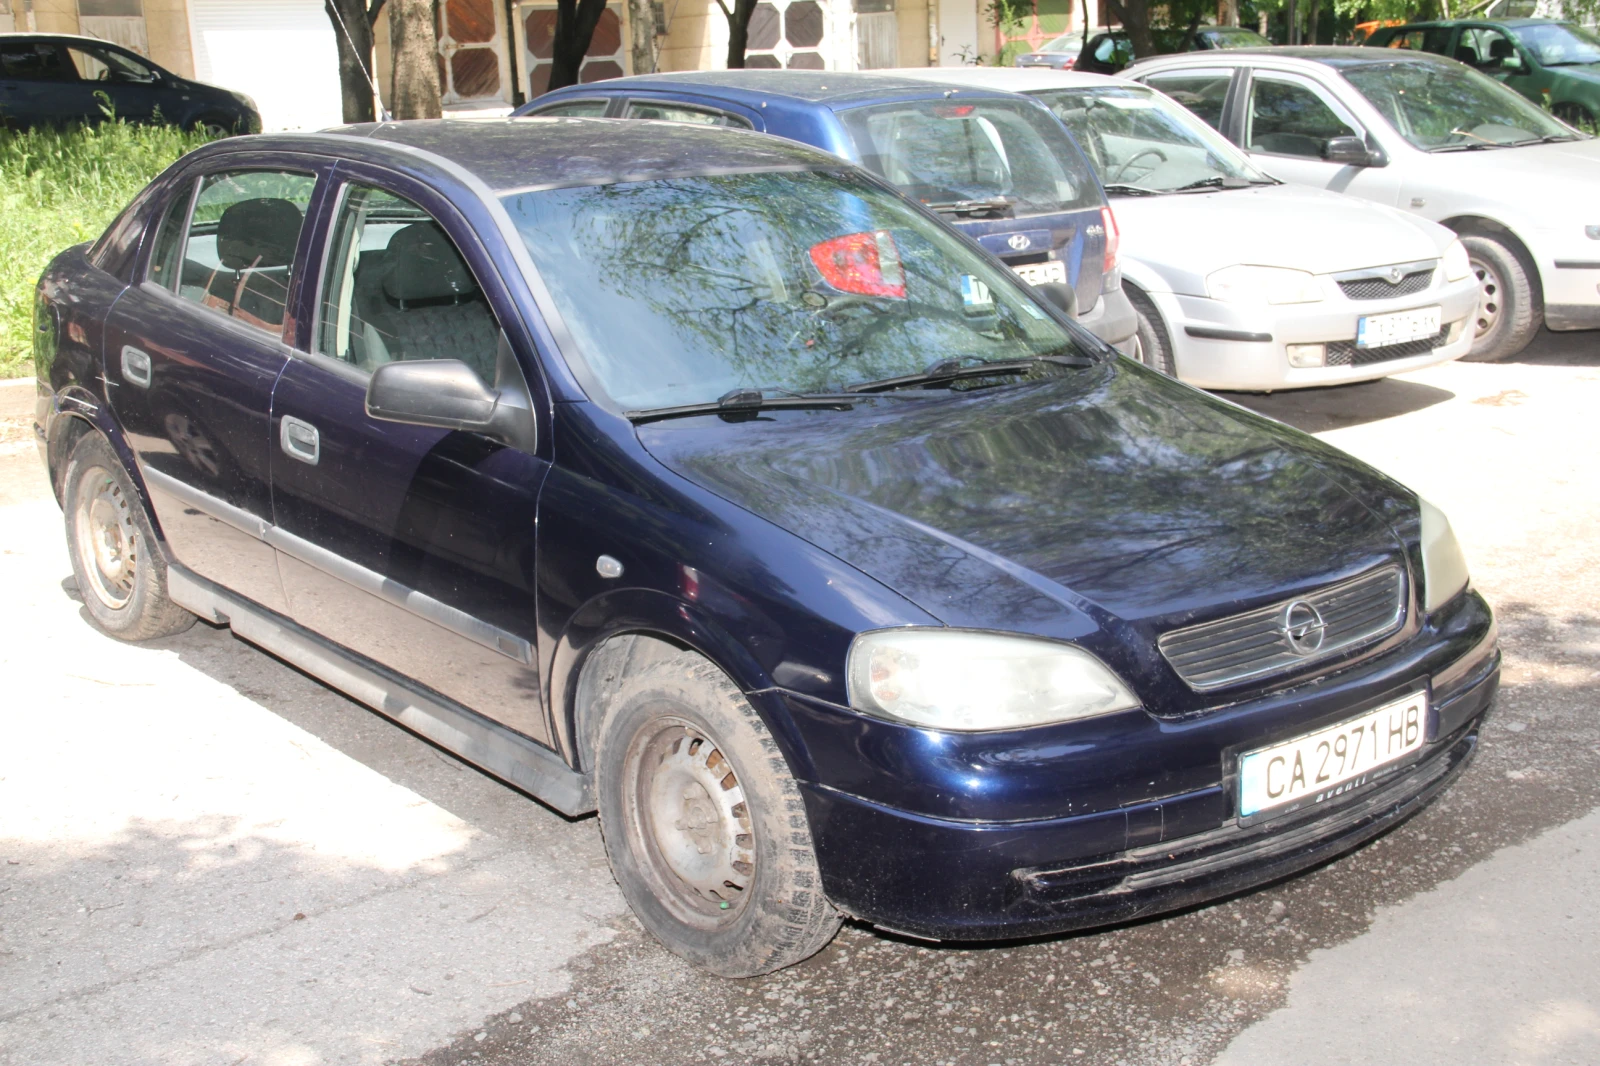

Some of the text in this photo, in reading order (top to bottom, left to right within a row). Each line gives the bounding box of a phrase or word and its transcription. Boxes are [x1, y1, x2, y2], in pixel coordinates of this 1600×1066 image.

[1266, 705, 1419, 799] CA 2971 HB
[1315, 773, 1367, 803] aventi
